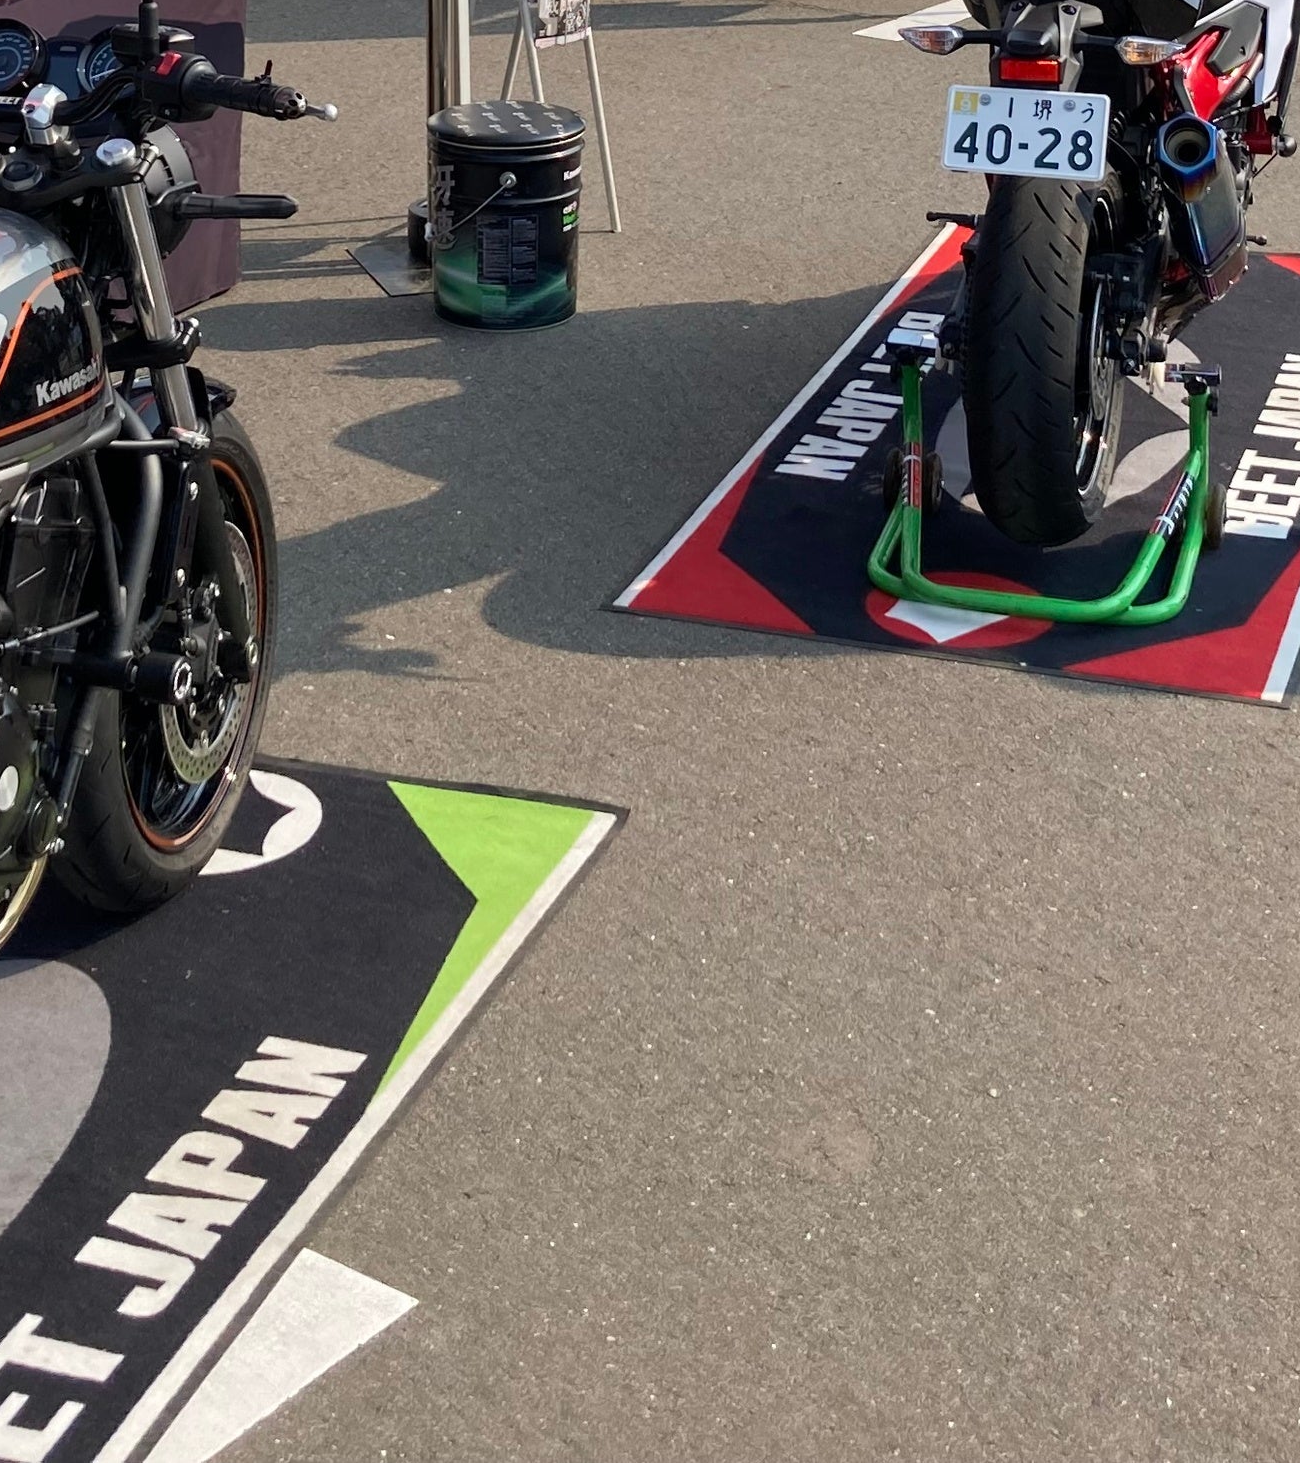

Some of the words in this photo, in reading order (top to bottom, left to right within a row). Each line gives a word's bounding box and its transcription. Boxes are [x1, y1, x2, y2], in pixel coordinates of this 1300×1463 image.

[1032, 99, 1053, 122] 堺
[1081, 102, 1095, 124] う
[953, 121, 1094, 172] 40-28
[35, 353, 101, 407] Kawasaki
[774, 379, 906, 482] JAPAN
[73, 1035, 369, 1320] JAPAN
